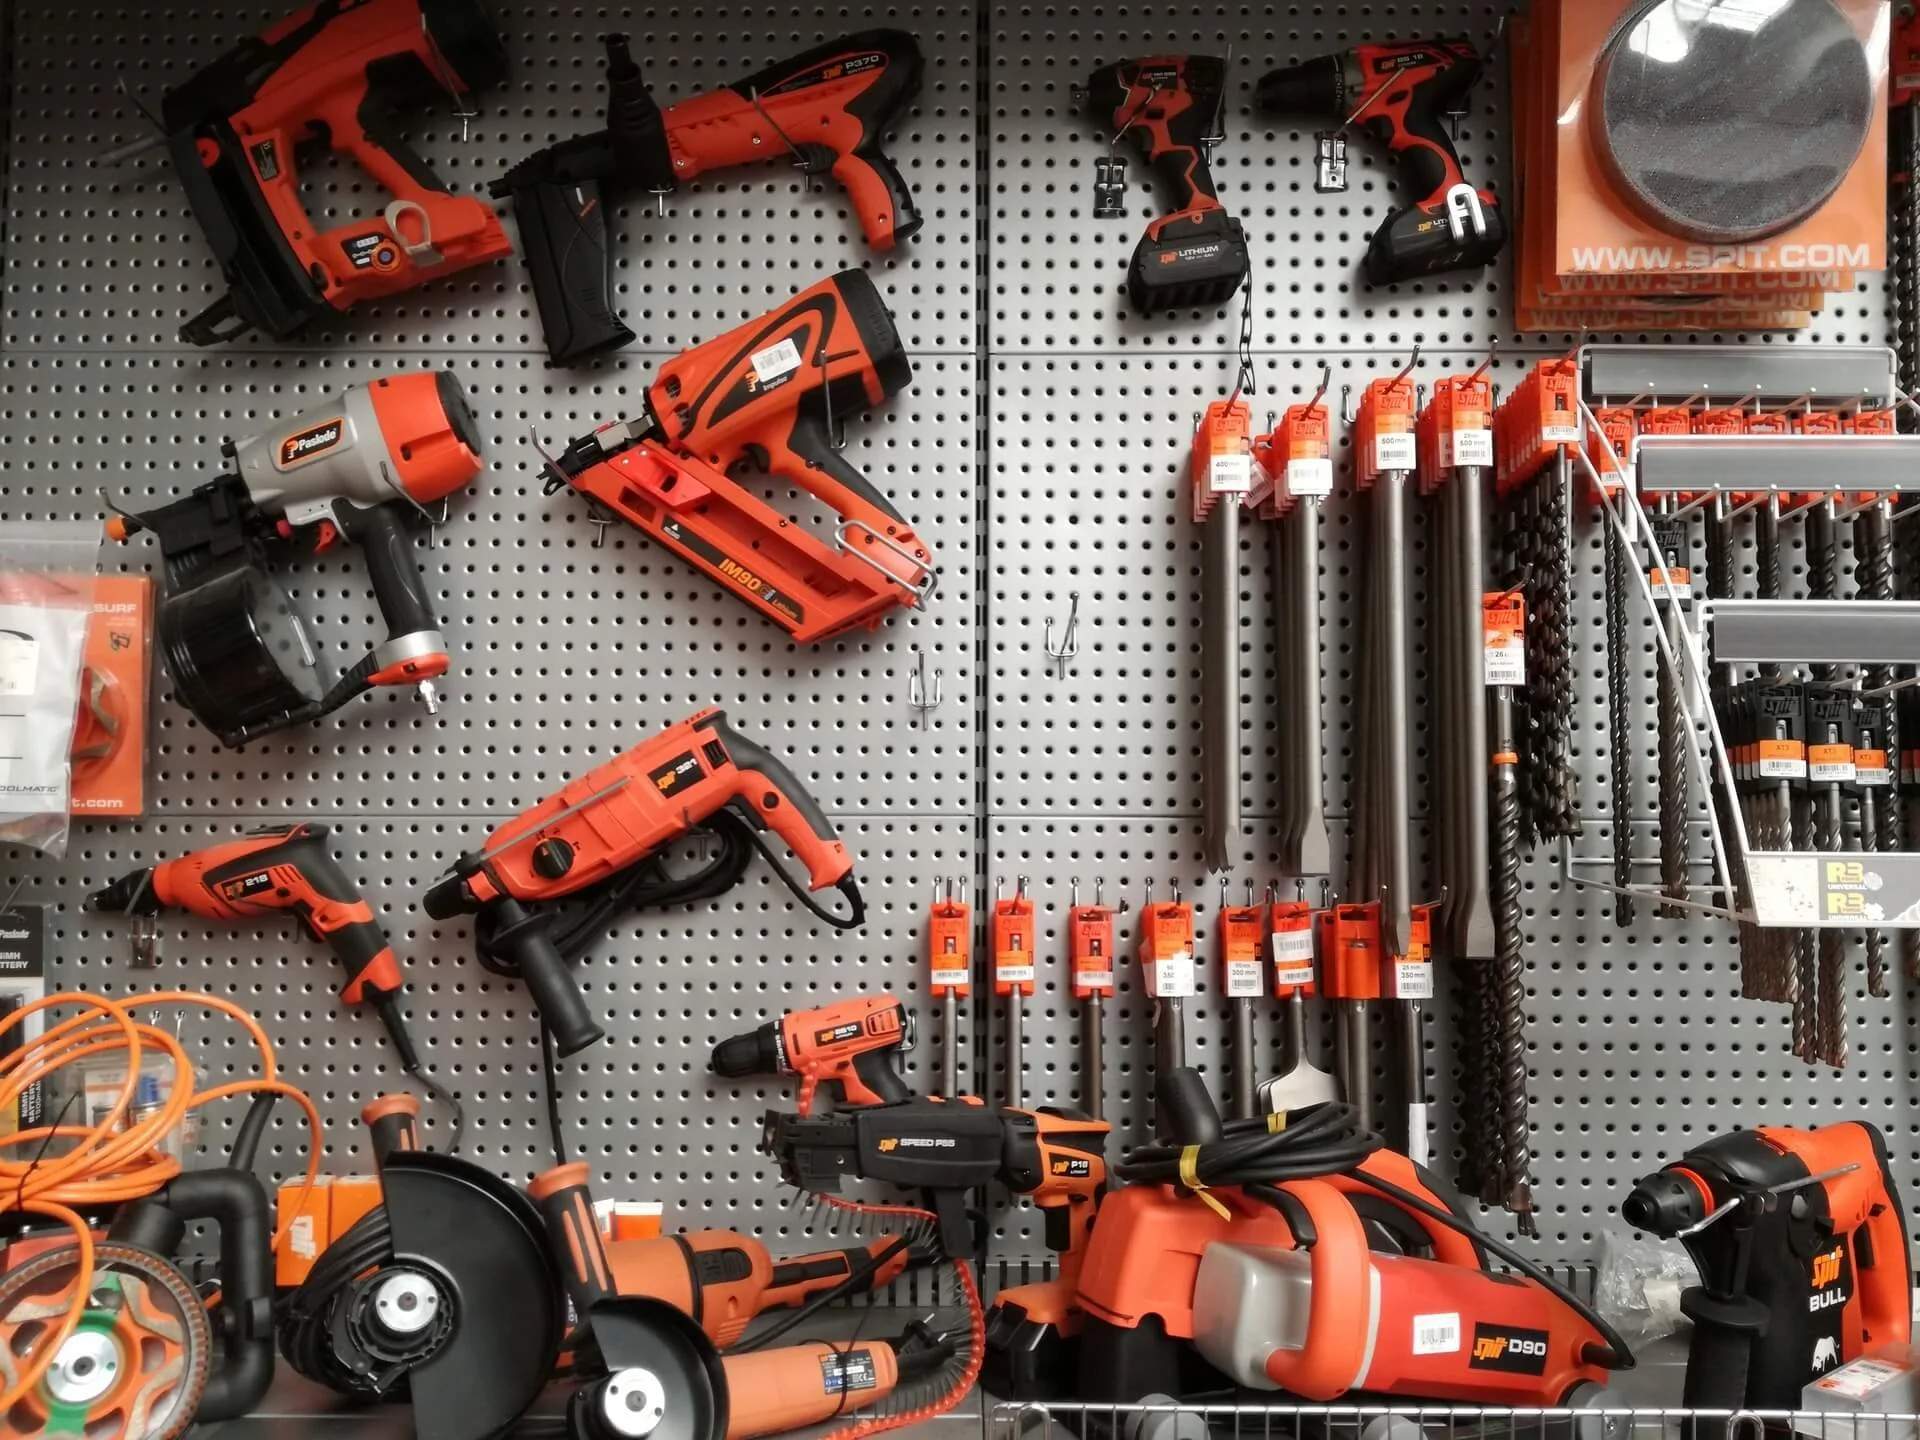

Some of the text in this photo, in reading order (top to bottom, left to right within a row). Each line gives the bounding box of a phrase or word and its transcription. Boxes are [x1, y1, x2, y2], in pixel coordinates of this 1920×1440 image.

[844, 55, 879, 69] P370
[1179, 245, 1219, 257] LITHIUM
[1572, 245, 1870, 271] WWW.SPIT.COM
[298, 428, 337, 451] Paslode
[93, 603, 137, 614] SURF
[675, 758, 698, 775] 321
[1827, 862, 1864, 883] R3
[1827, 892, 1865, 913] R3
[900, 1138, 934, 1147] SPEED
[1809, 1287, 1847, 1313] BULL
[1508, 1338, 1547, 1356] D90
